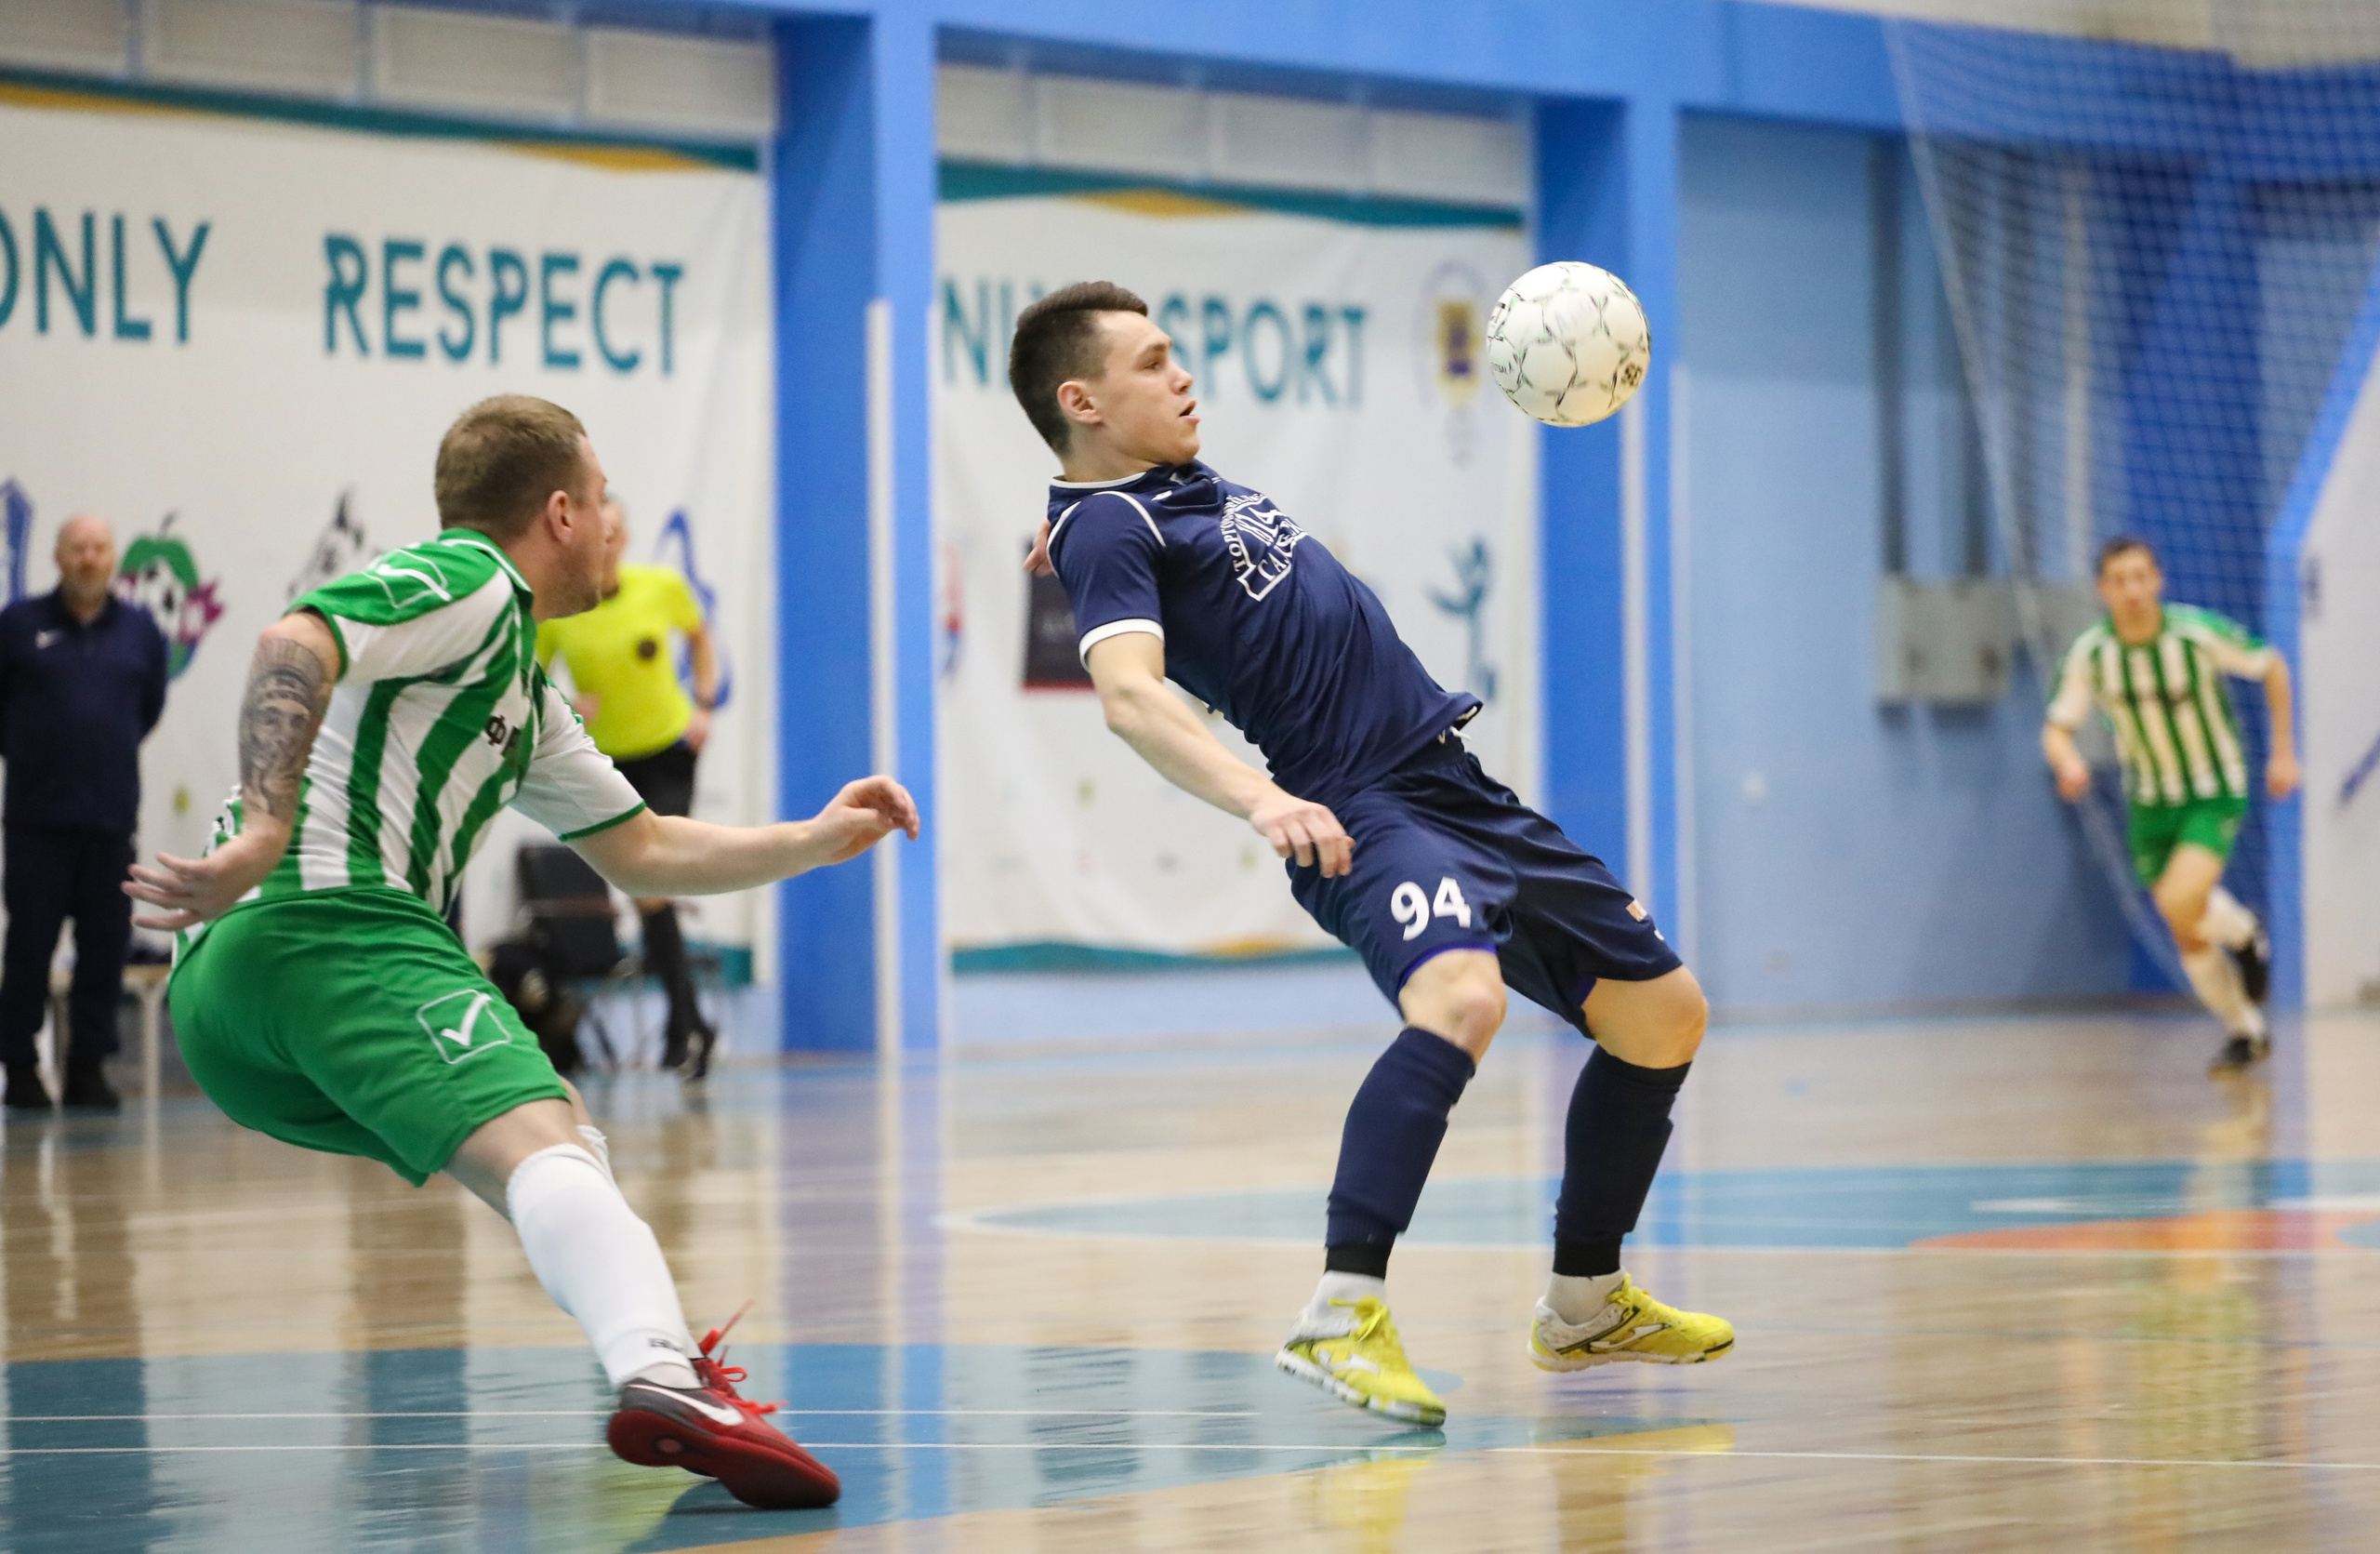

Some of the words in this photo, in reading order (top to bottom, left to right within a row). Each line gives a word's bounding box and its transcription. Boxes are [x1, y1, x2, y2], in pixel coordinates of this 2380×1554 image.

[324, 232, 685, 377] RESPECT
[1158, 290, 1368, 407] SPORT
[1391, 876, 1472, 941] 94
